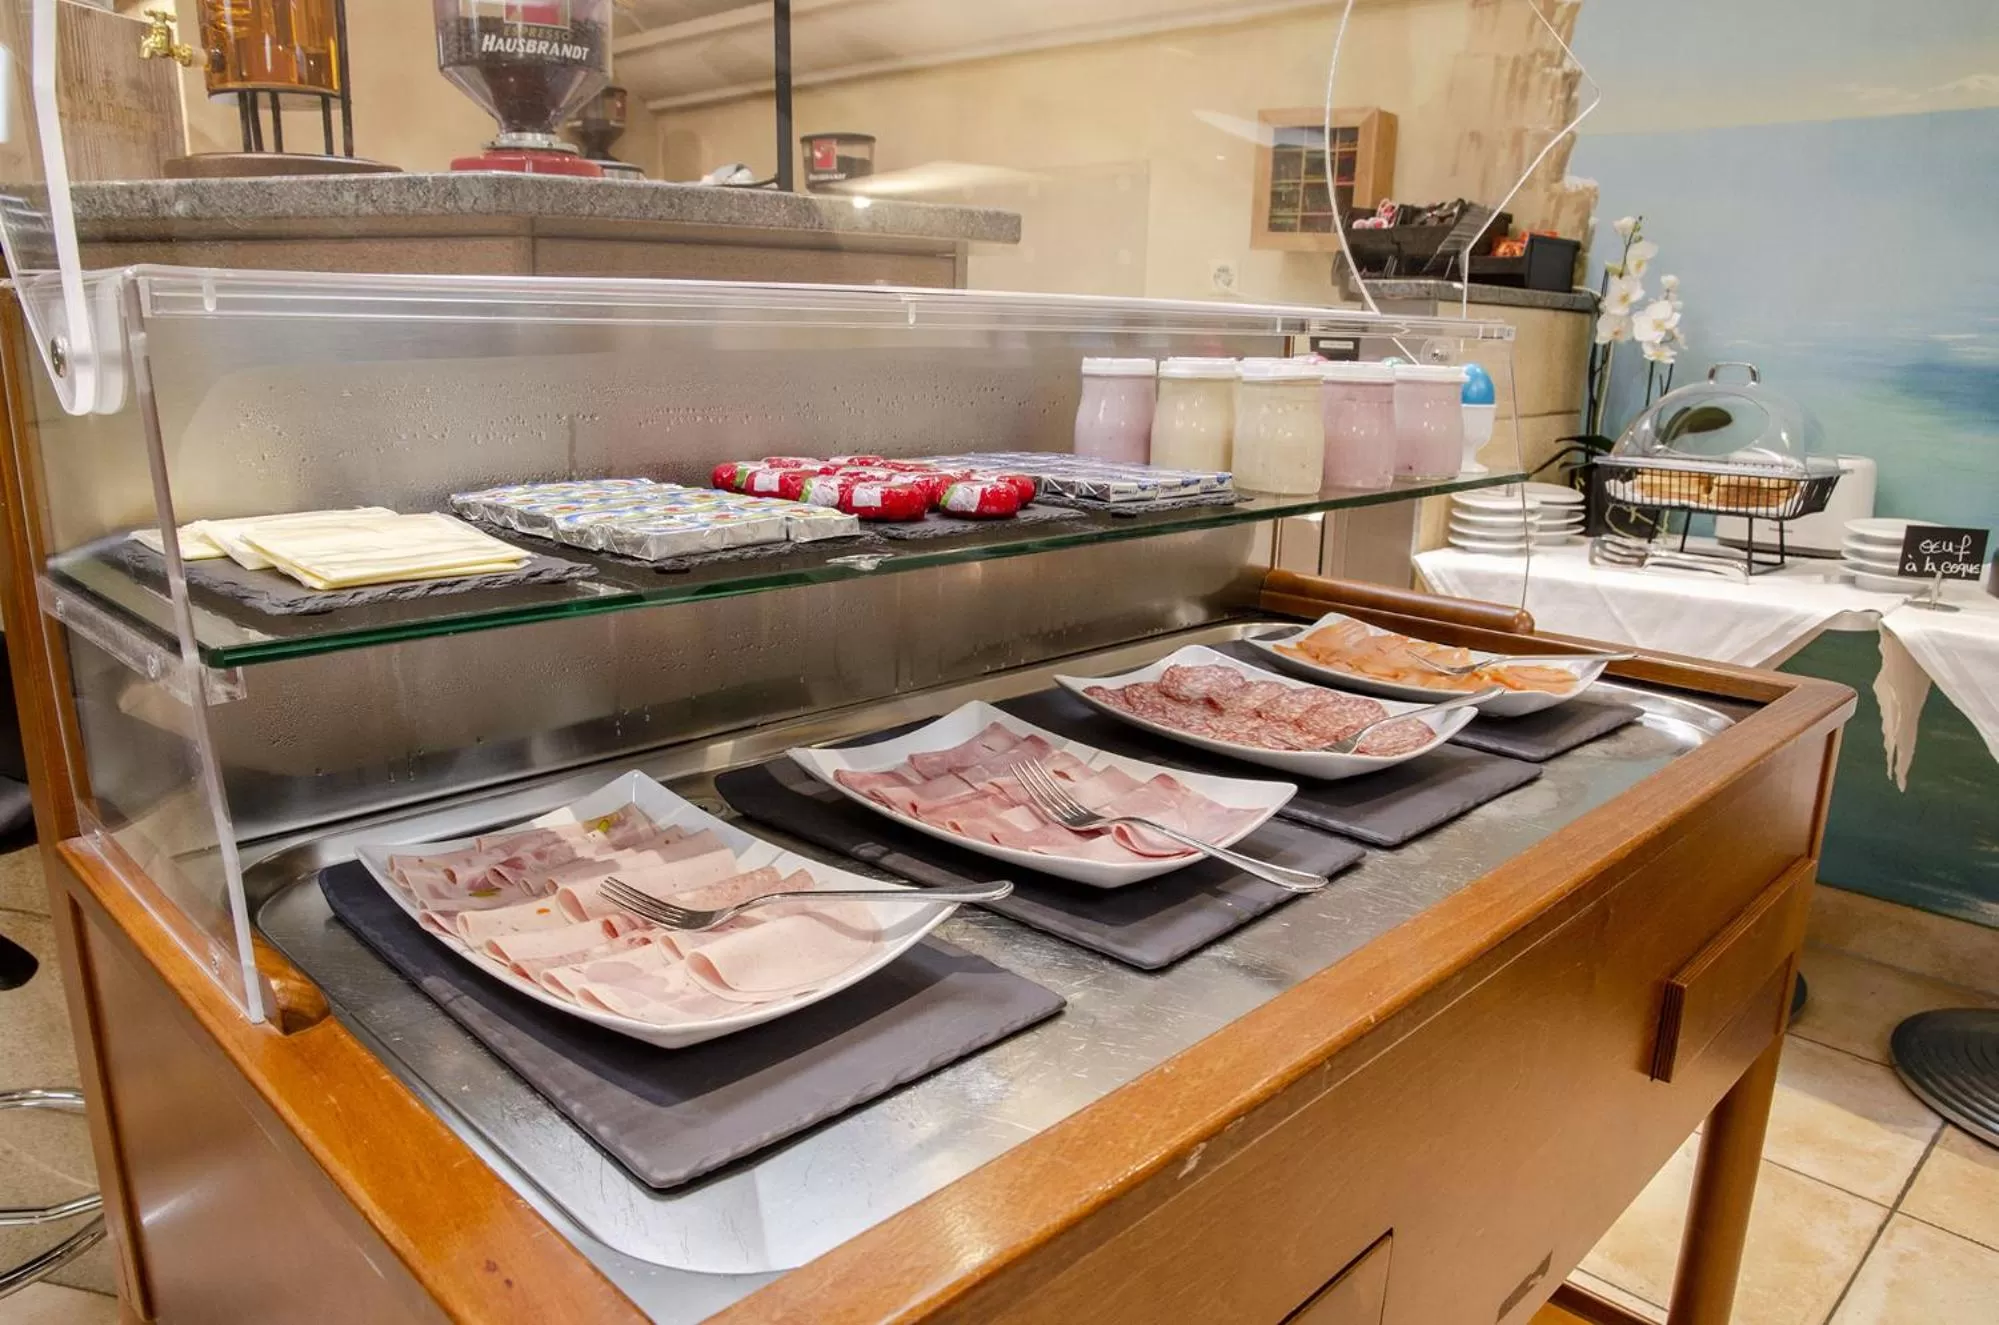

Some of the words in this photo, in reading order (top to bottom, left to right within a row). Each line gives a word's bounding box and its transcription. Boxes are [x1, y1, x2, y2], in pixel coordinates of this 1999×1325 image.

[503, 25, 571, 40] ESPRESSO
[481, 34, 590, 60] HAUSBRANDT
[1905, 553, 1917, 572] à
[1924, 555, 1937, 573] la
